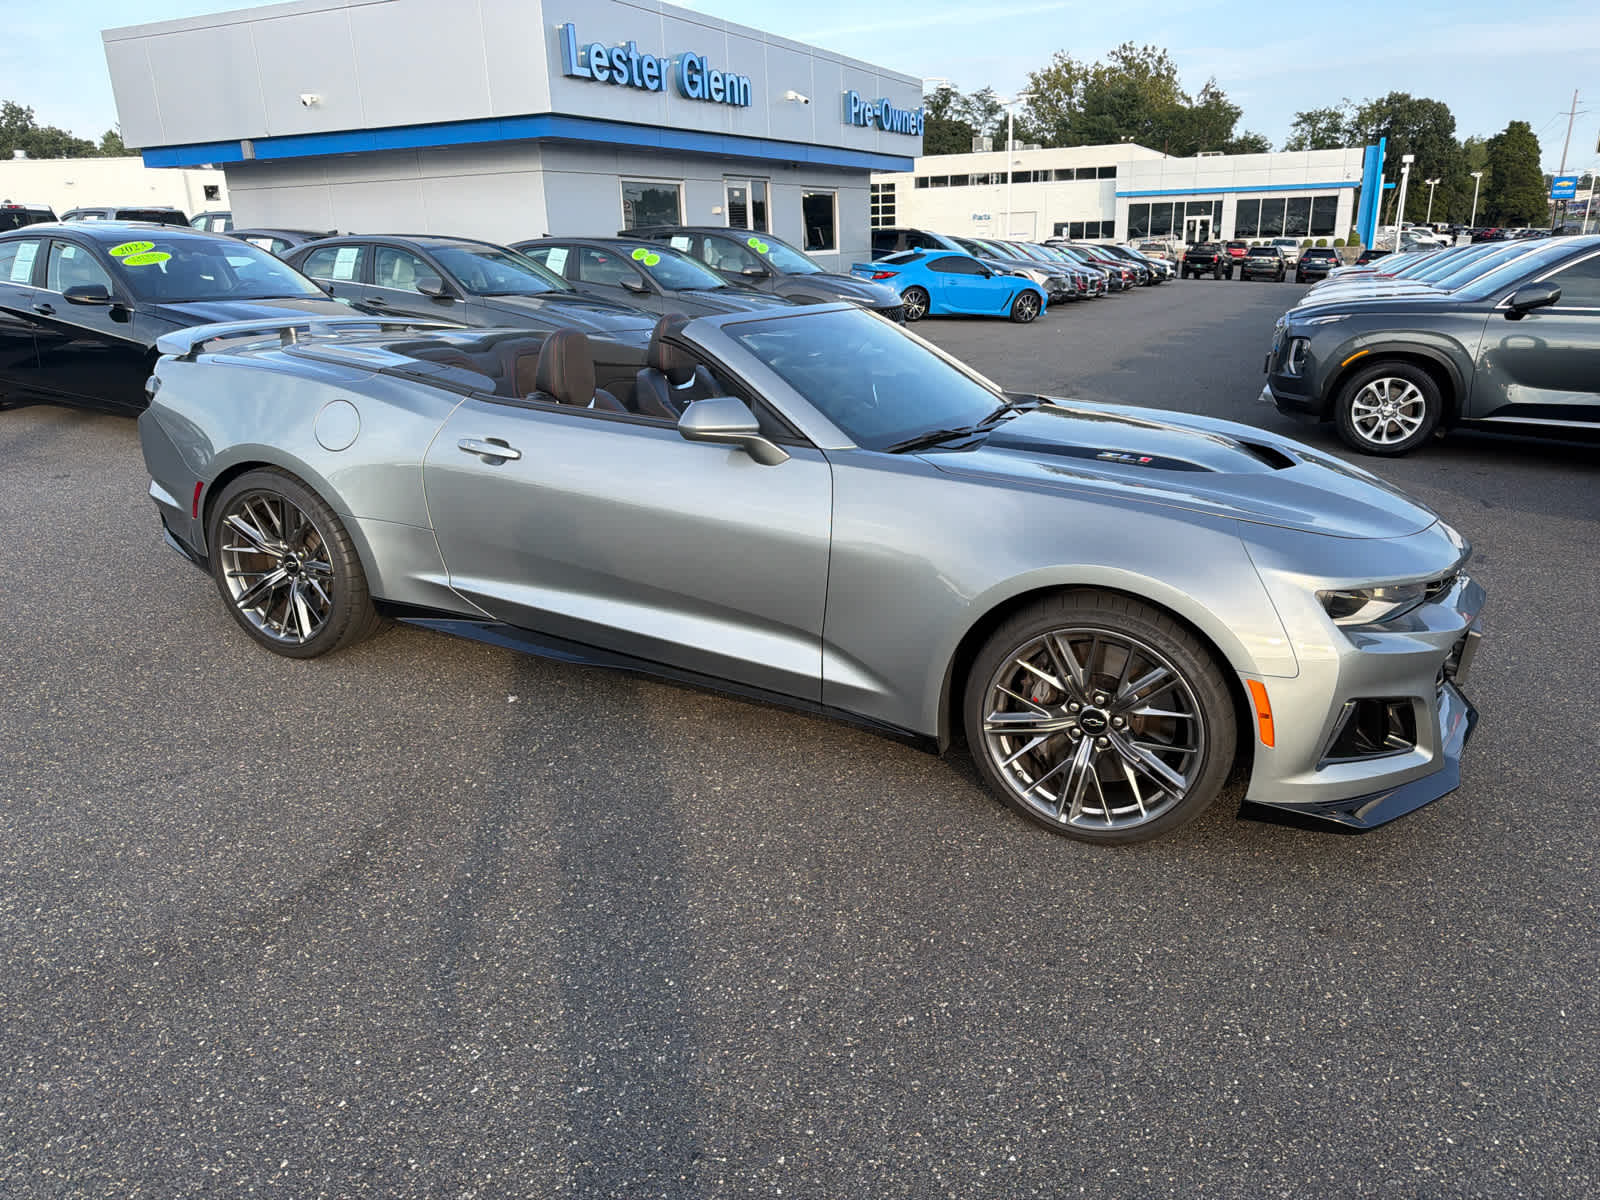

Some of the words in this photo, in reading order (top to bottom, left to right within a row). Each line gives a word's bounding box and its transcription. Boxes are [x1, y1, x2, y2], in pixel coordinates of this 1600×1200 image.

[561, 23, 669, 91] Lester
[676, 51, 751, 106] Glenn
[846, 90, 924, 136] Pre-Owned
